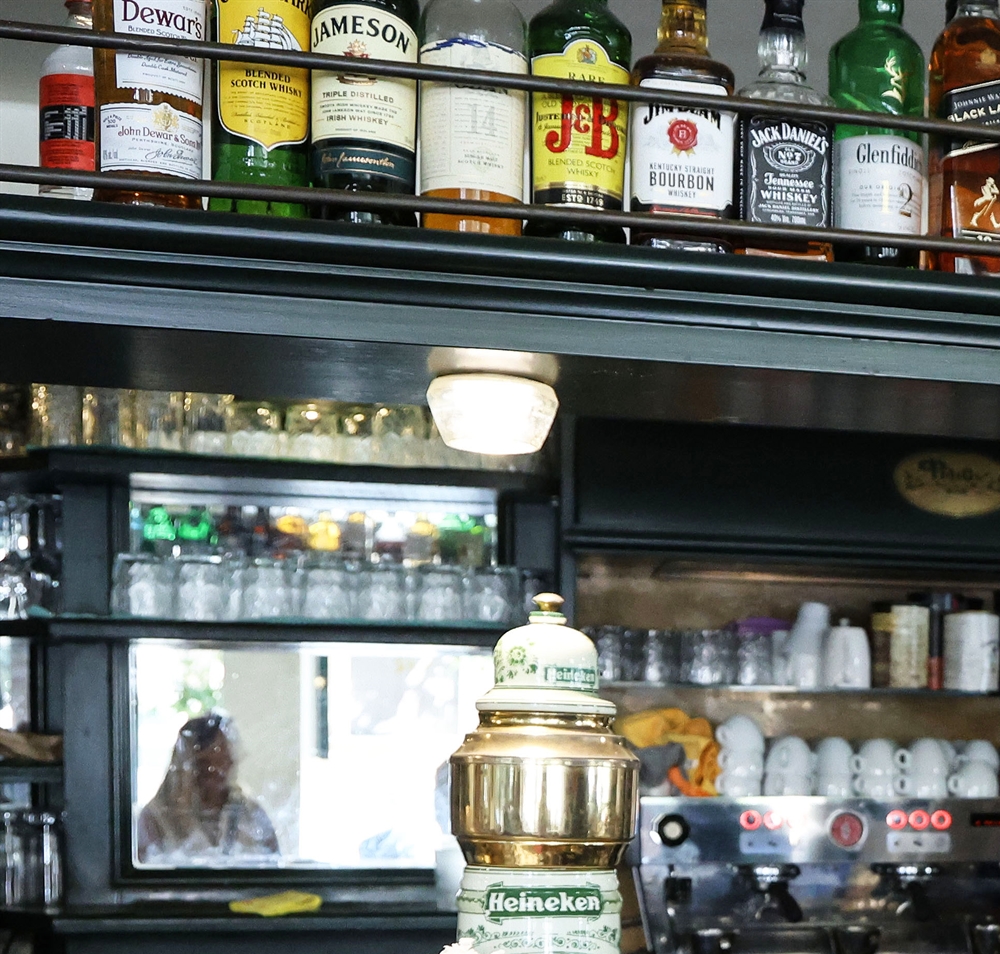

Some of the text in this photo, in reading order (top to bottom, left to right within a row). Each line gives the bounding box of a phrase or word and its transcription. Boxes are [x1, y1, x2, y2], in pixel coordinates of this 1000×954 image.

[122, 0, 203, 39] Dewar's
[128, 25, 155, 35] BLENDED
[313, 15, 410, 54] JAMESON
[245, 69, 292, 84] BLENDED
[231, 79, 303, 99] SCOTCH WHISKY
[322, 90, 395, 104] TRIPLE DISTILLED
[952, 93, 987, 111] JOHNNIE
[326, 114, 389, 126] IRISH WHISKEY
[118, 126, 141, 137] John
[142, 126, 174, 141] Dewar
[750, 122, 829, 155] JACK DANIEL'S
[548, 157, 584, 167] BLENDED
[856, 143, 922, 171] Glenfiddi
[566, 167, 600, 178] WHISKY
[649, 161, 715, 176] KENTUCKY STRAIGHT
[649, 171, 715, 192] BOURBON
[763, 172, 815, 189] Tennessee
[668, 189, 697, 199] WHISKEY
[760, 189, 818, 204] WHISKEY
[488, 891, 601, 913] Heineken
